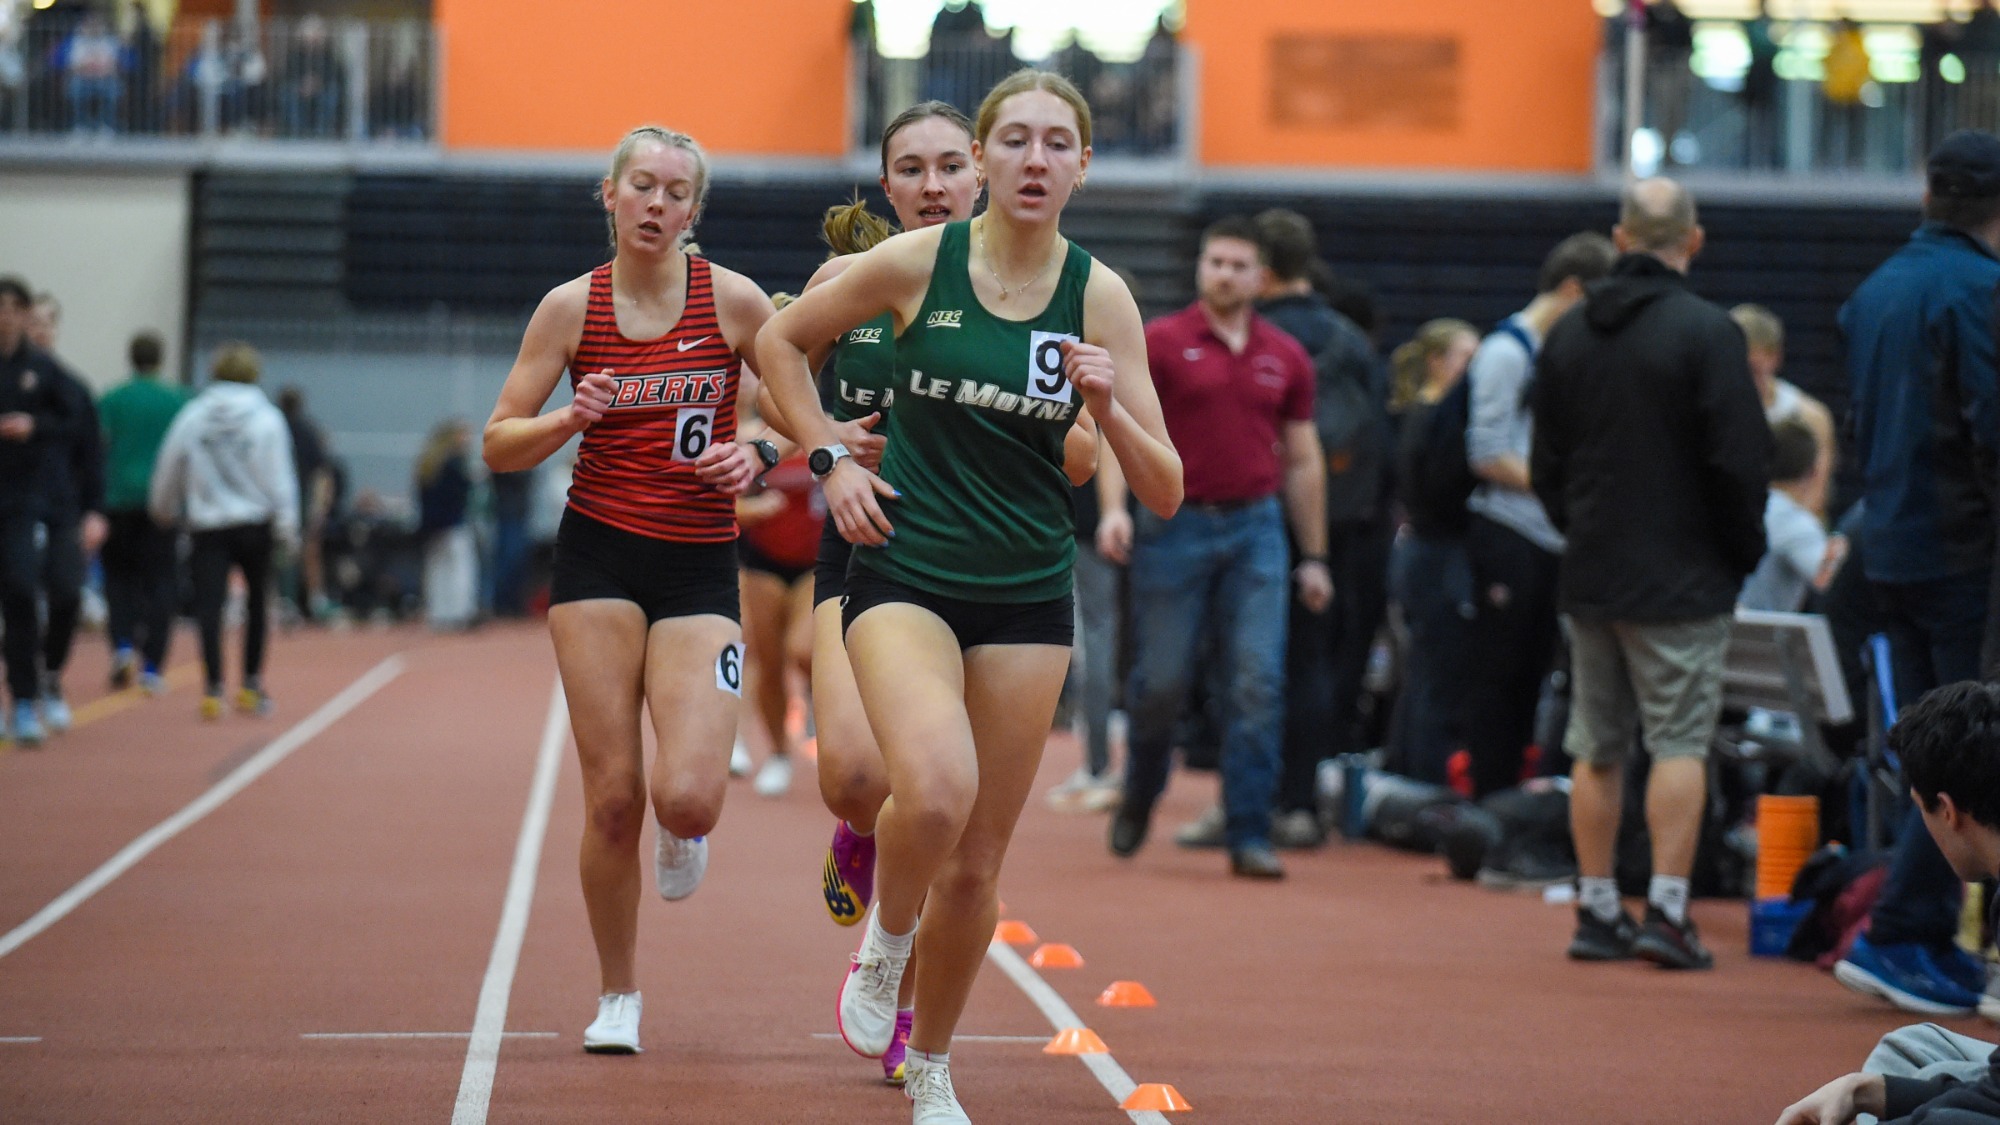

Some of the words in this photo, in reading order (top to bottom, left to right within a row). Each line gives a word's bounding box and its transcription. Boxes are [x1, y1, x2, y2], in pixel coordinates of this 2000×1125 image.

[849, 328, 883, 341] NEC
[926, 310, 963, 324] NEC
[1035, 340, 1067, 395] 9
[609, 373, 726, 406] BERTS
[839, 378, 876, 406] LE
[909, 368, 951, 399] LE
[954, 378, 1075, 420] MOYNE
[679, 414, 708, 459] 6
[720, 644, 739, 690] 6
